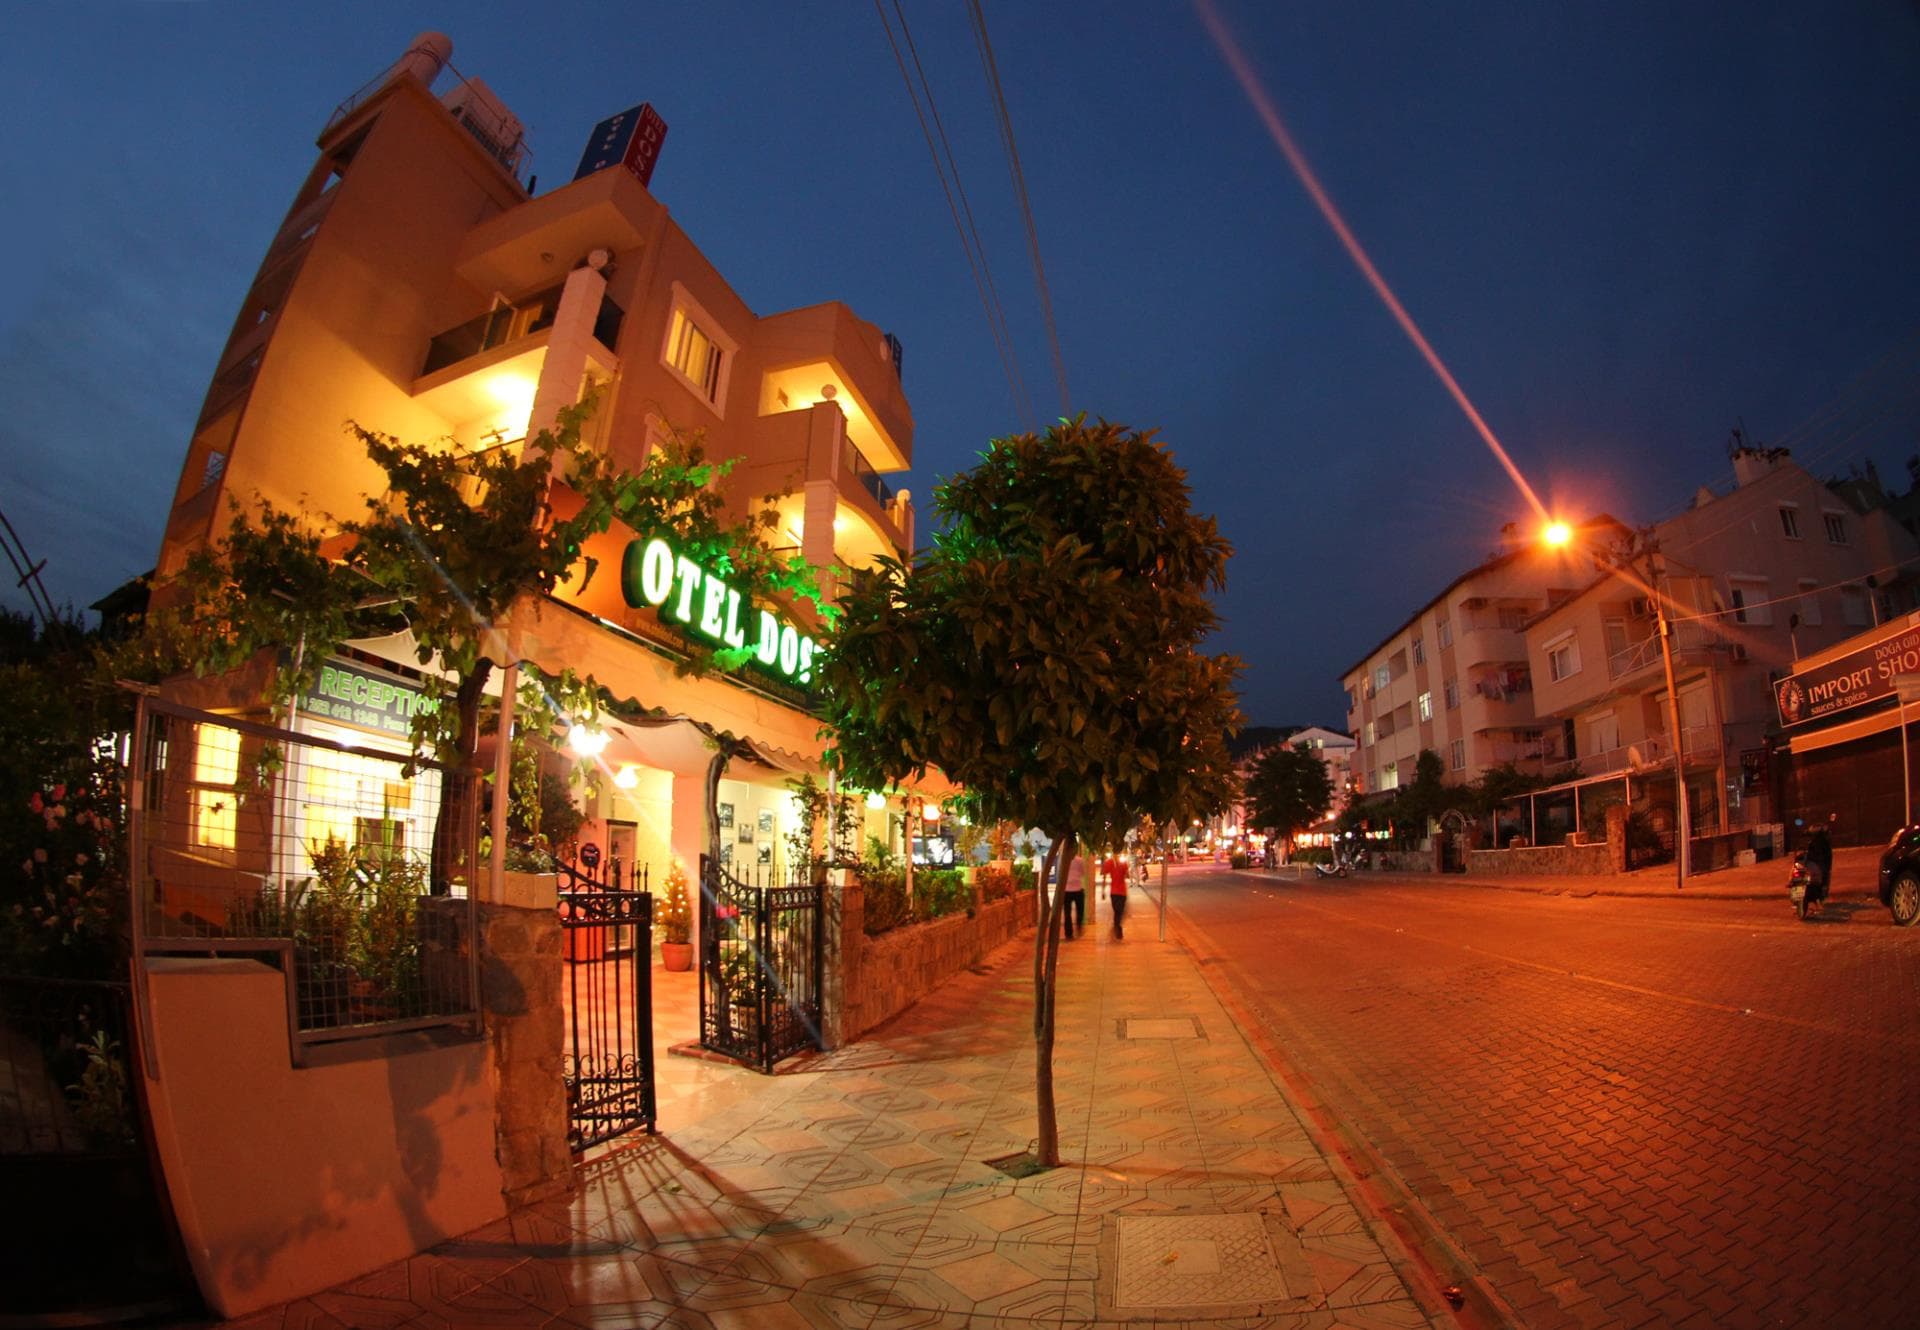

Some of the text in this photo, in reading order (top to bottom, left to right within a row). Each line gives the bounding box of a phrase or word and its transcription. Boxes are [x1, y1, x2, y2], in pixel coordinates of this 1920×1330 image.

[642, 539, 826, 684] OTEL DOS
[1808, 647, 1920, 704] IMPORT SHO
[1836, 697, 1843, 708] &
